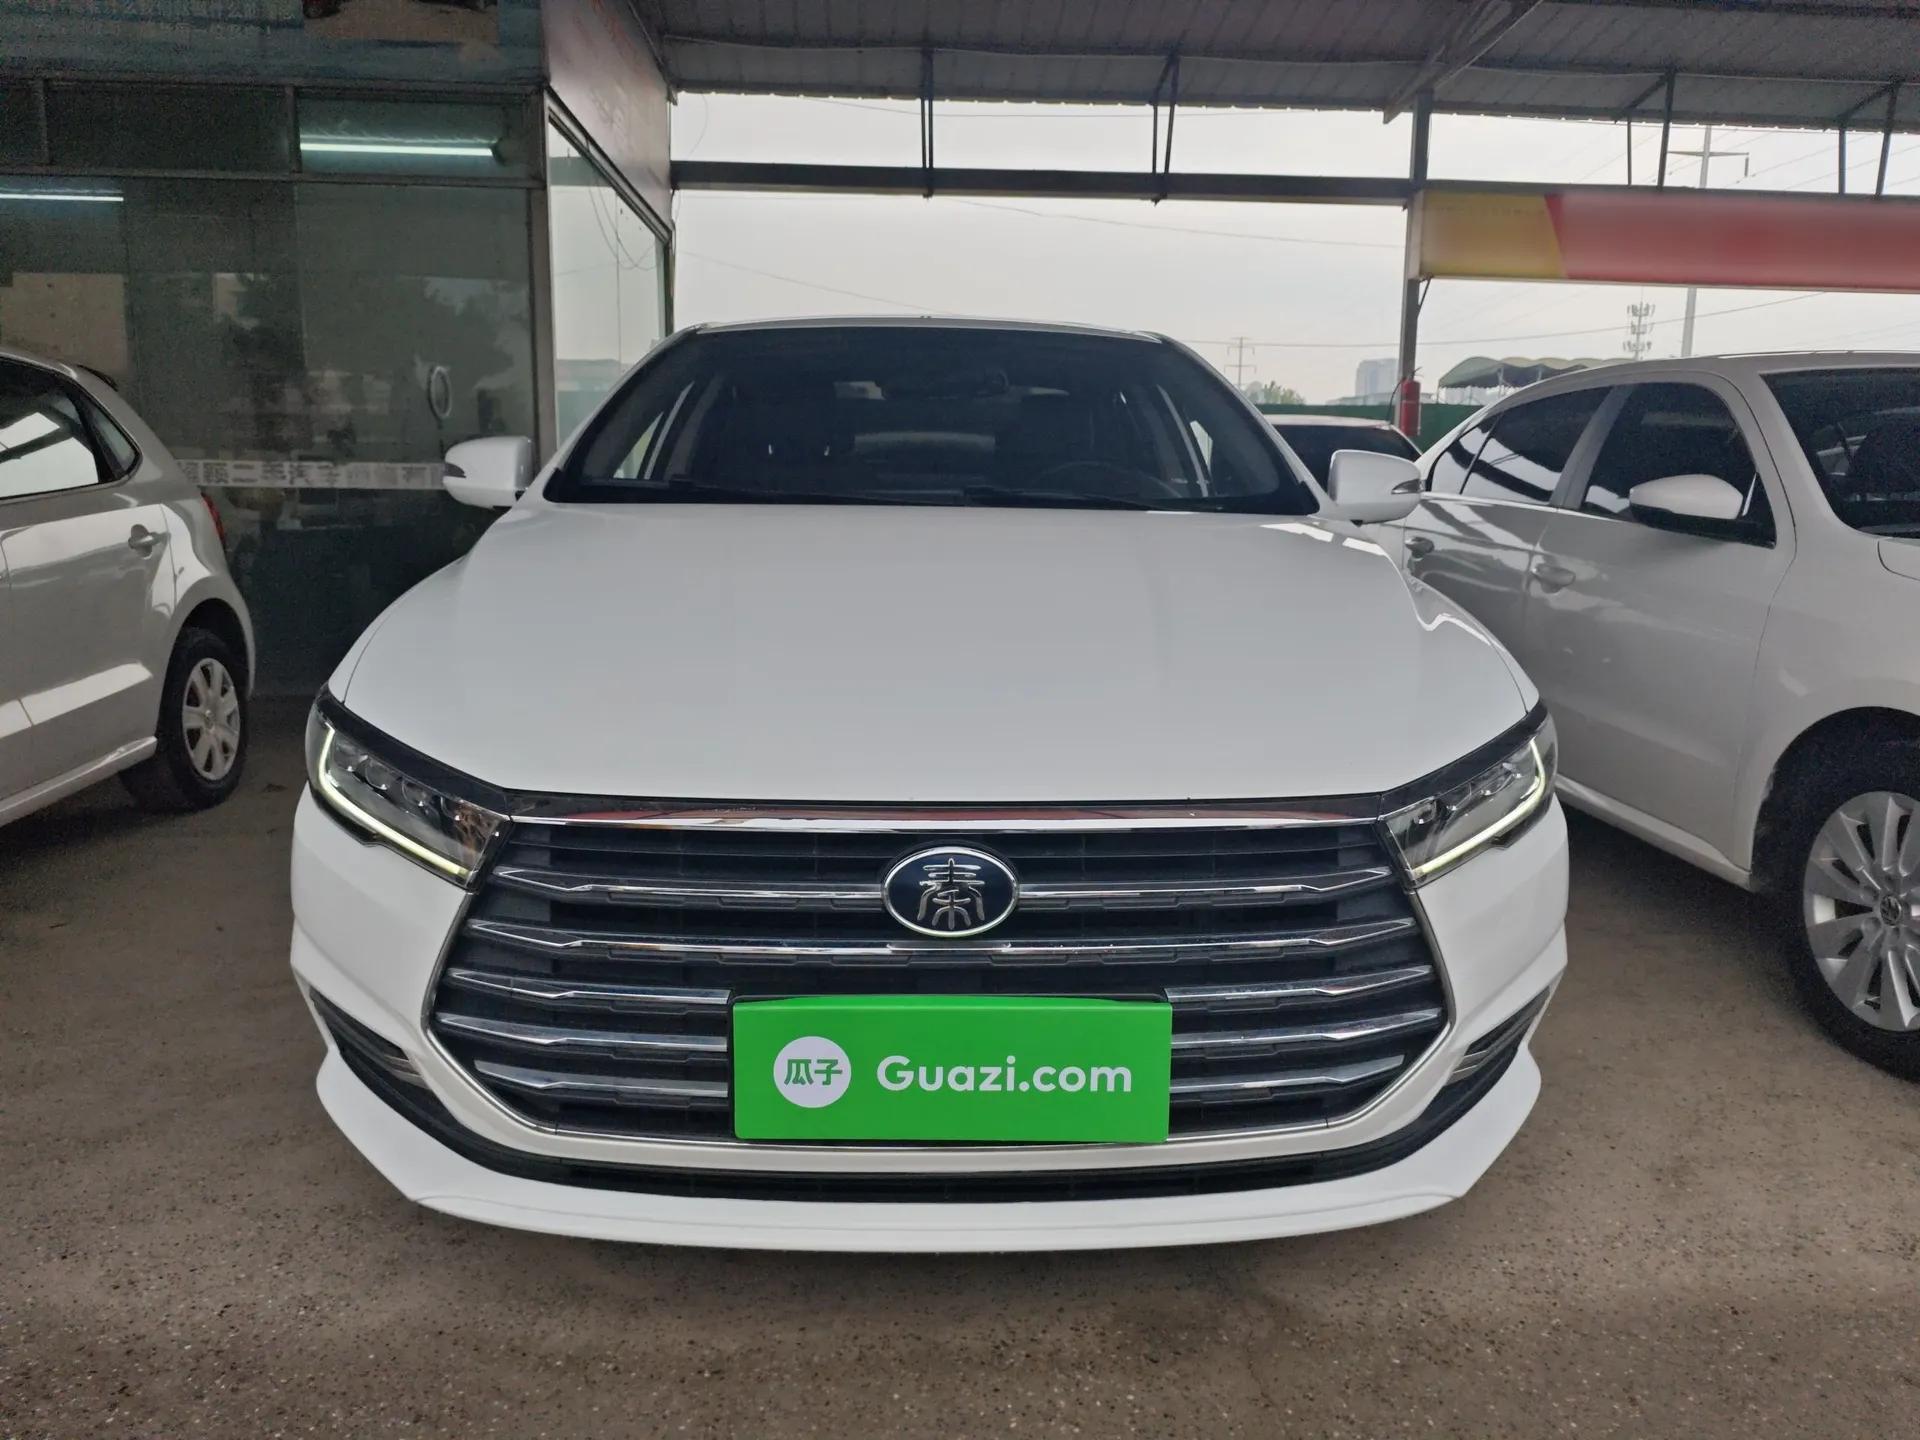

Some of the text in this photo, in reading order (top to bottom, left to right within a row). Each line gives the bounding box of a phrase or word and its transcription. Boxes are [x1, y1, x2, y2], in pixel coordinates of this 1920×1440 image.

[917, 857, 985, 930] 秦
[784, 1057, 843, 1087] 瓜子
[876, 1055, 1132, 1093] Guazi.com
